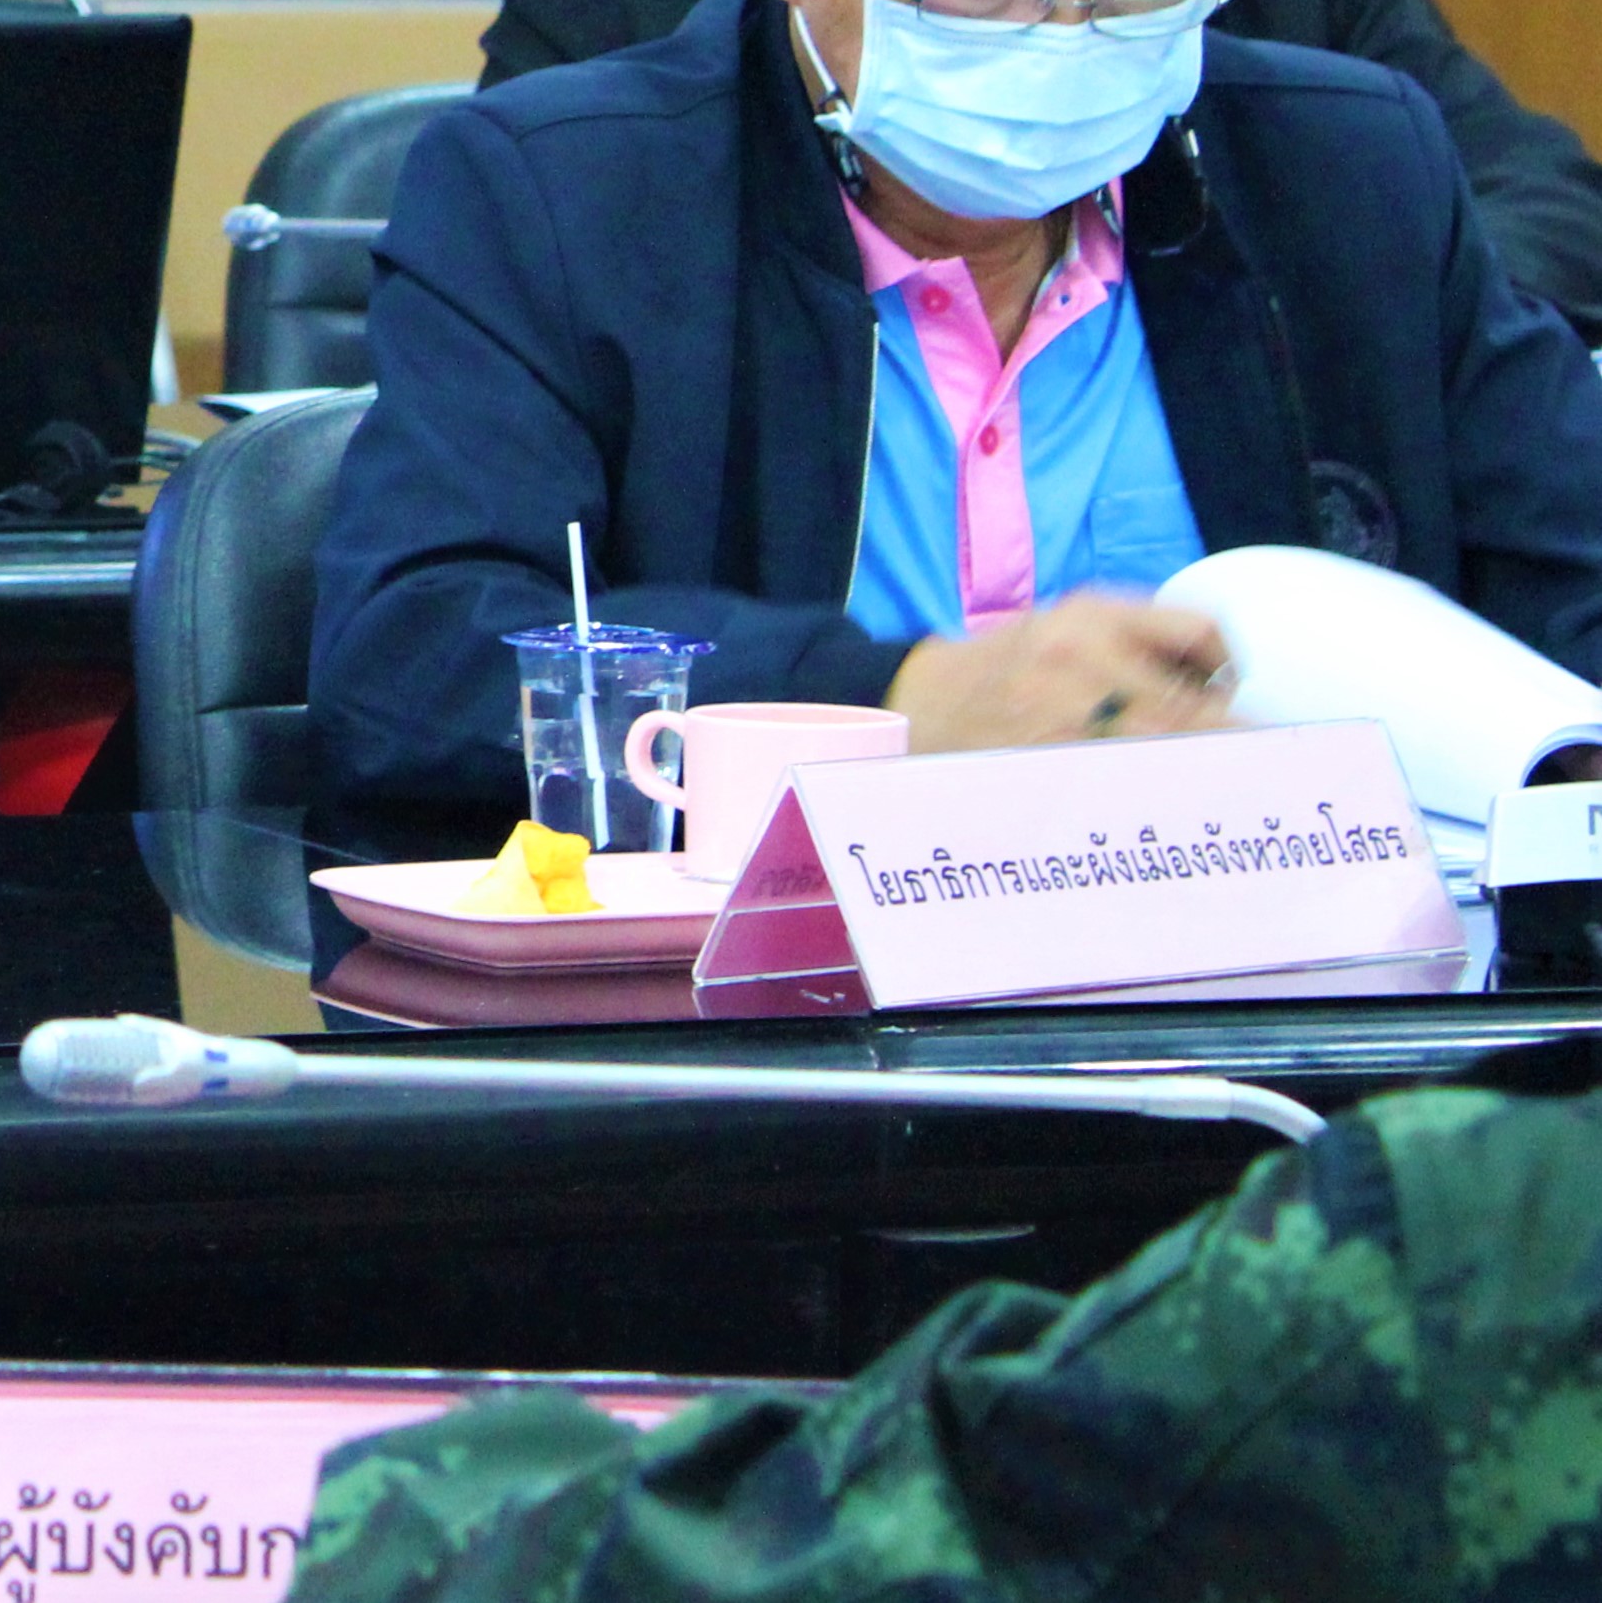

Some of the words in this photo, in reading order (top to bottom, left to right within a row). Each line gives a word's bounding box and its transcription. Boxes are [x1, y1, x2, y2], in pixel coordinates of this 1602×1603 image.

[849, 803, 1408, 909] โยธาธิการและผังเมืองจังหวัดยโสธร
